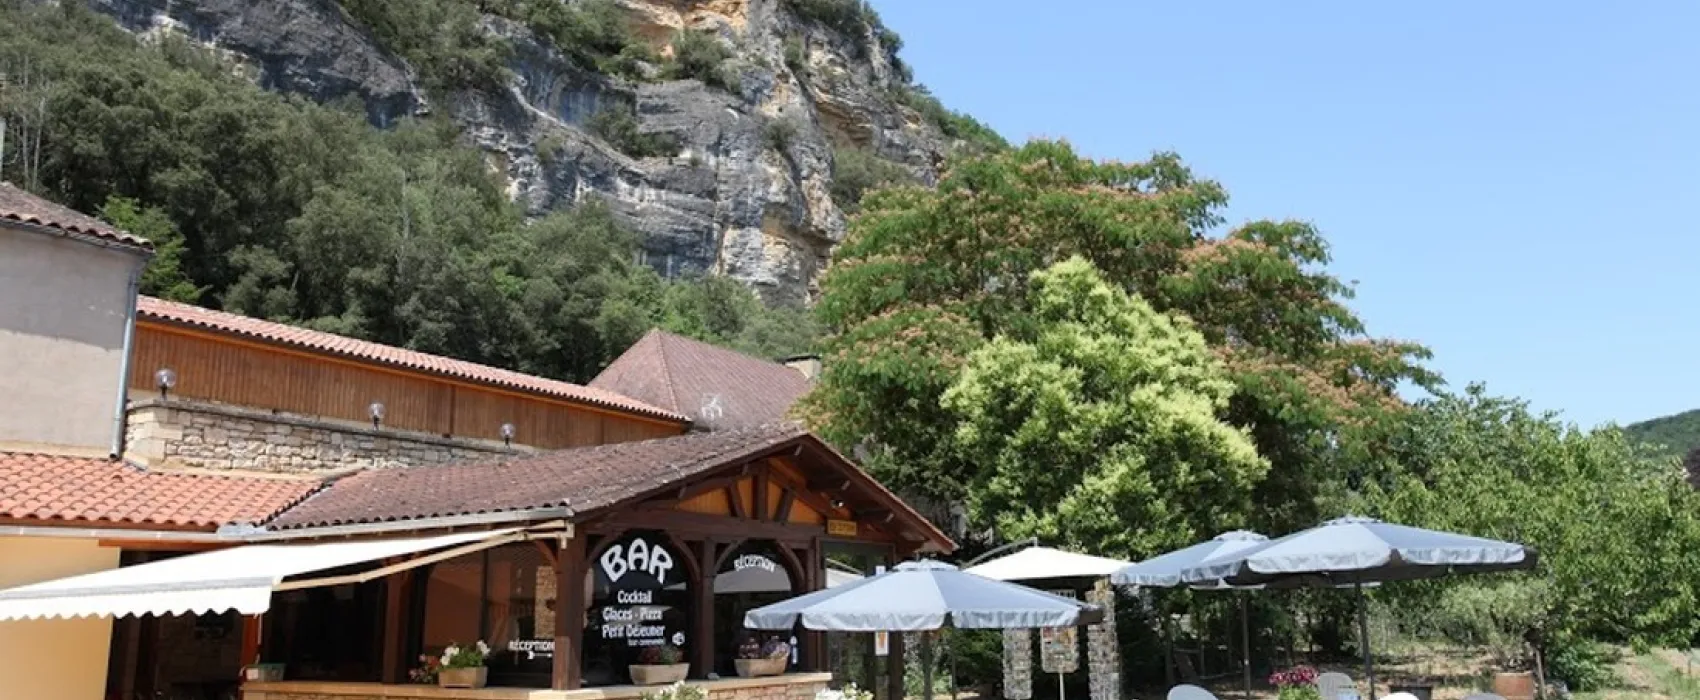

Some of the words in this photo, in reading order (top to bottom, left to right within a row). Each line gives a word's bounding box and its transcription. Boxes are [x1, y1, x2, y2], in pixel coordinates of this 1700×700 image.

[600, 537, 673, 584] BAR
[617, 589, 653, 604] Cocktail
[602, 606, 633, 622] Glaces
[640, 606, 663, 621] Pizza
[602, 624, 625, 639] Petit
